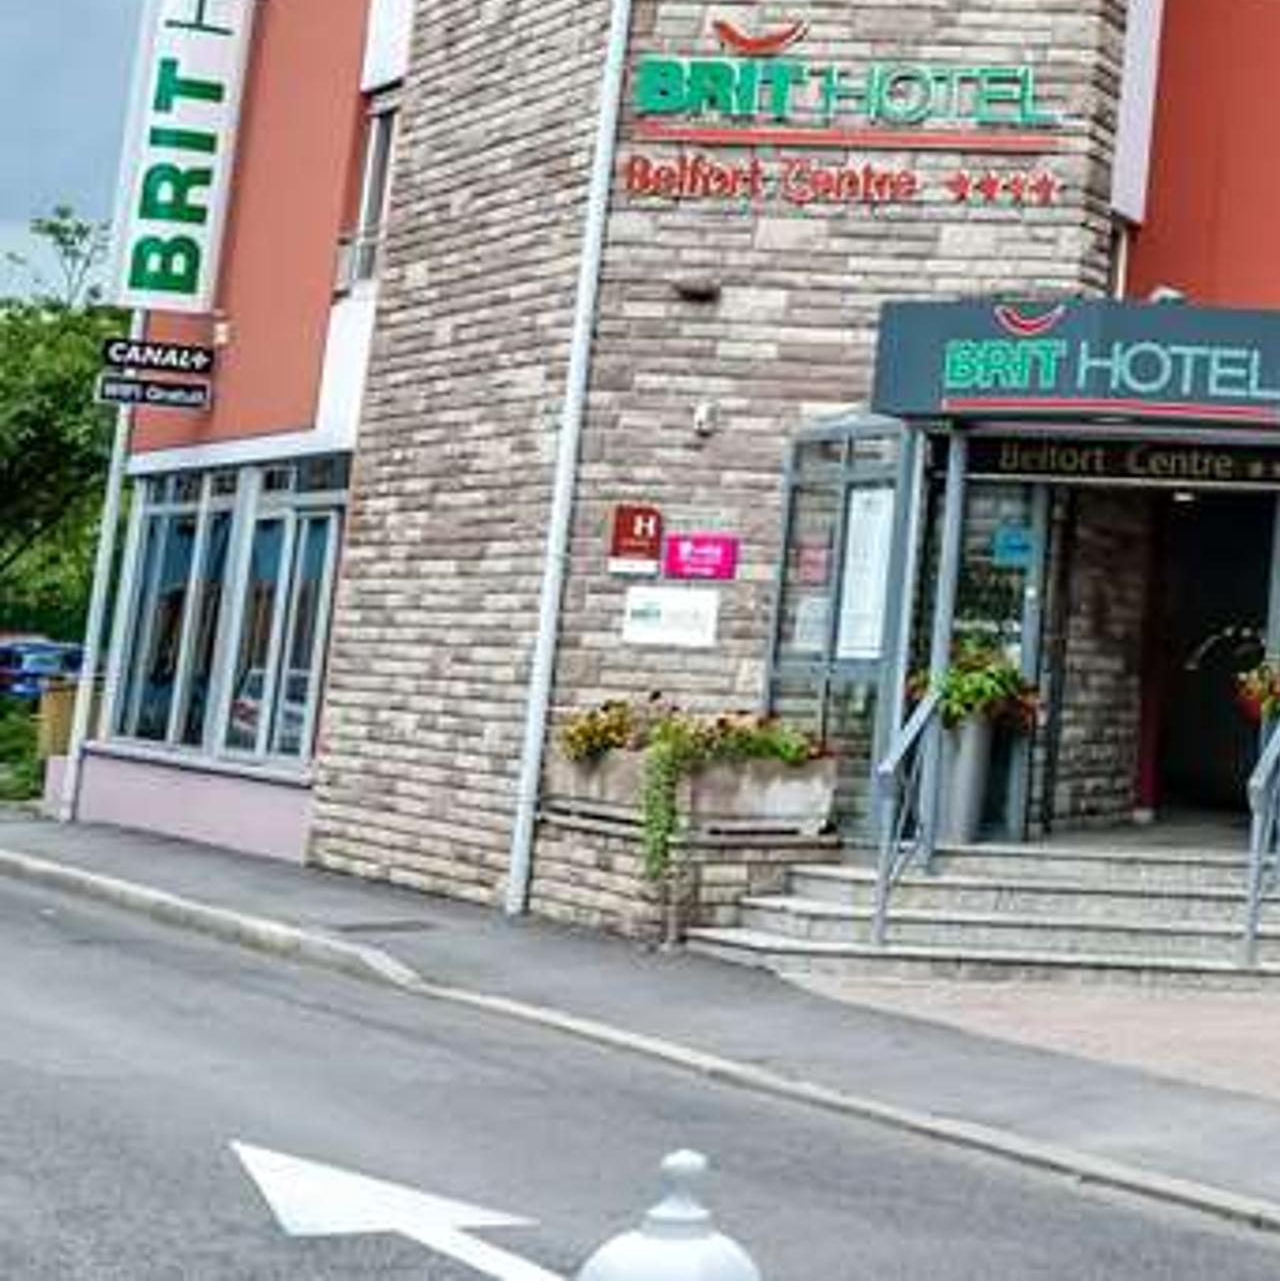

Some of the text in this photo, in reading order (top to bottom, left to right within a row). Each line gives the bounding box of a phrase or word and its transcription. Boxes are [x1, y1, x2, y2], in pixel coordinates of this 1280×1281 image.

[633, 58, 1058, 125] BRIT HOTEL
[128, 57, 225, 295] BRIT
[626, 154, 920, 203] Belfort Centre
[107, 341, 211, 370] CANAL+
[945, 338, 1067, 389] BRIT
[1126, 446, 1234, 478] Centre
[633, 515, 655, 537] H
